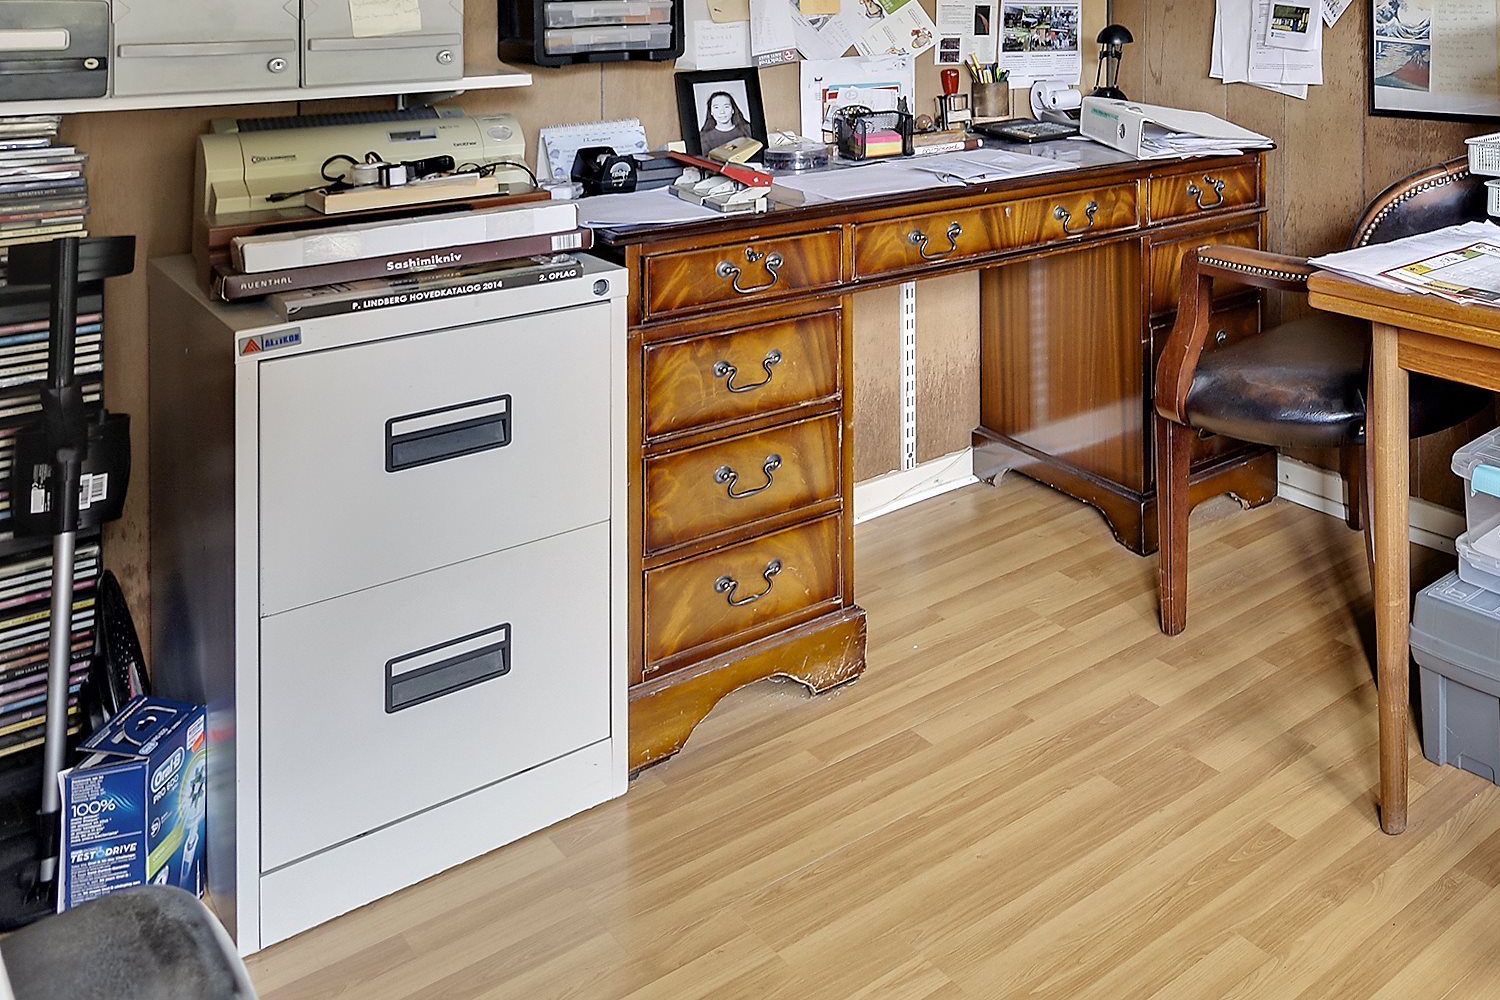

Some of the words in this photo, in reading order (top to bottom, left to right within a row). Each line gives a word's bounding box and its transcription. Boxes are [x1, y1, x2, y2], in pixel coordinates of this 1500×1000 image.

[453, 140, 477, 148] brother
[386, 252, 462, 272] Sashimikniv
[240, 276, 293, 291] AUENTHAL
[548, 269, 577, 281] OPLAG
[352, 300, 361, 310] P.
[363, 294, 408, 310] LINDBERG
[409, 284, 481, 303] HOVEDKATALOG
[482, 280, 503, 292] 2014
[154, 754, 182, 786] Oral-B
[153, 788, 166, 805] PRO
[71, 799, 116, 817] 100%
[71, 852, 96, 863] TEST
[104, 843, 137, 857] DRIVE
